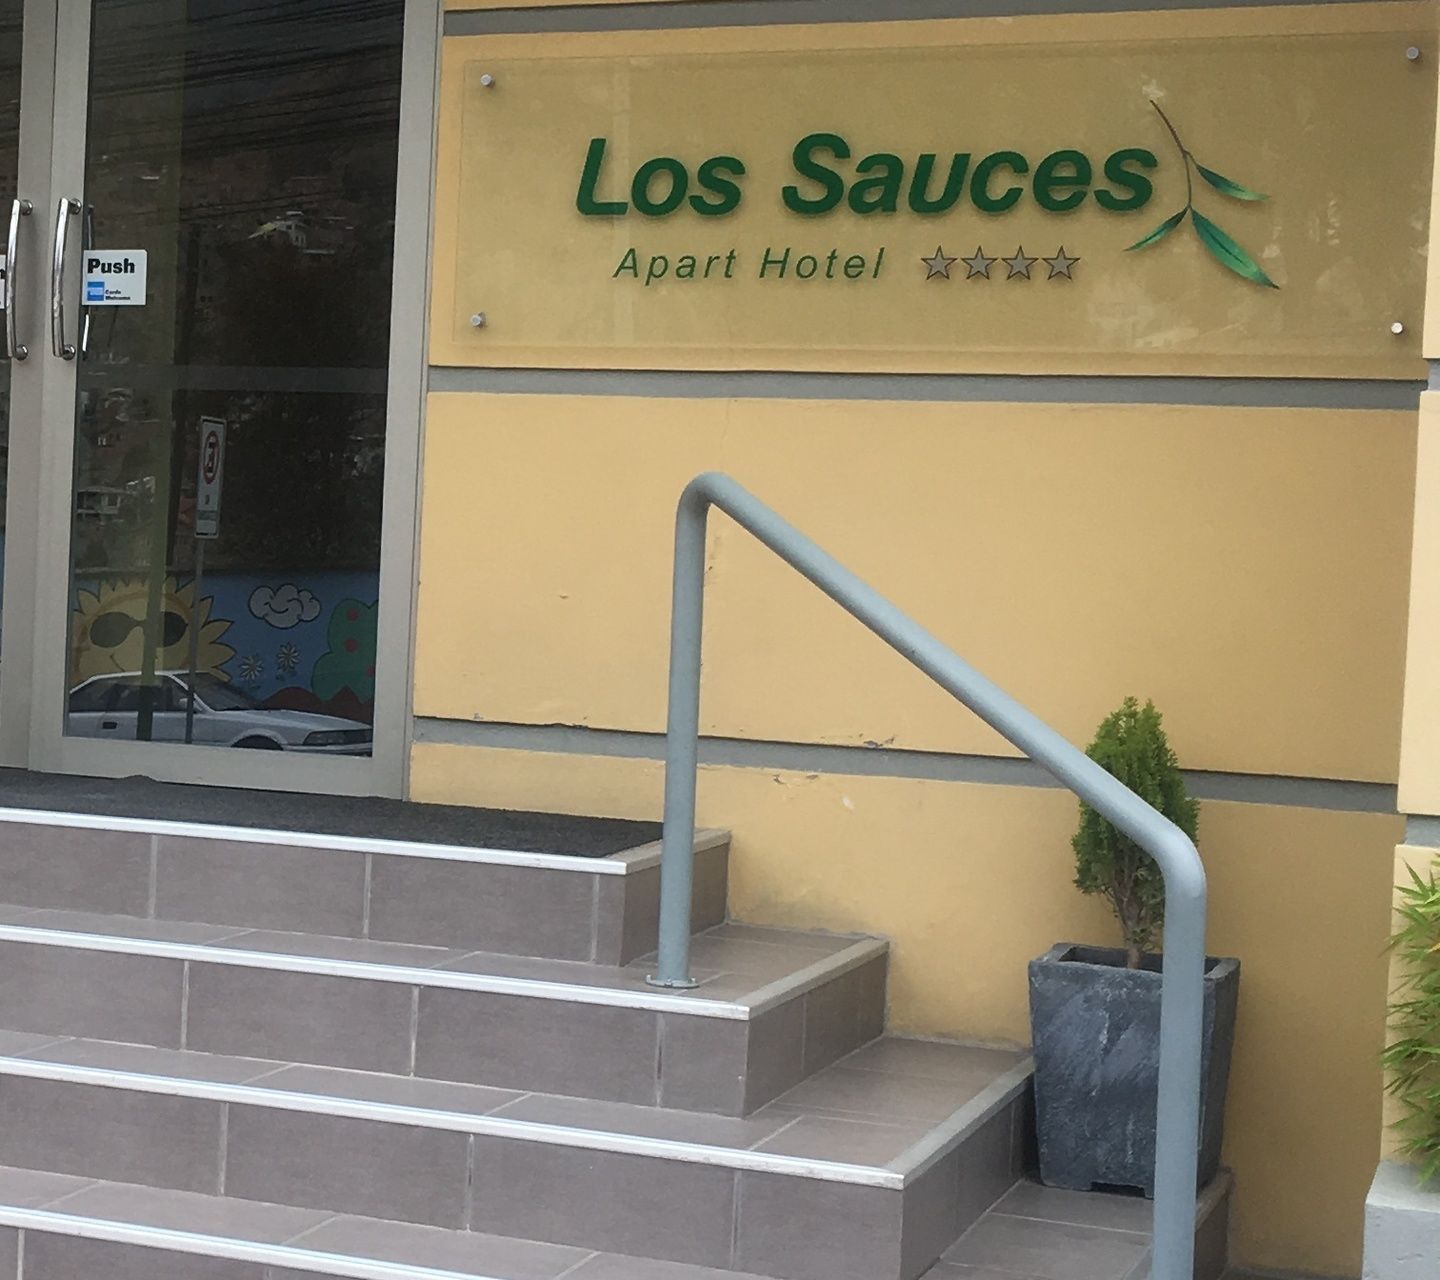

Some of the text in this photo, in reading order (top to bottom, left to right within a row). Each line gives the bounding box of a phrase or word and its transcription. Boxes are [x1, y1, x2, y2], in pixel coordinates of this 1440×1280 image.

[575, 132, 1158, 218] Los Sauces
[87, 258, 135, 274] Push
[613, 246, 885, 286] Apart Hotel
